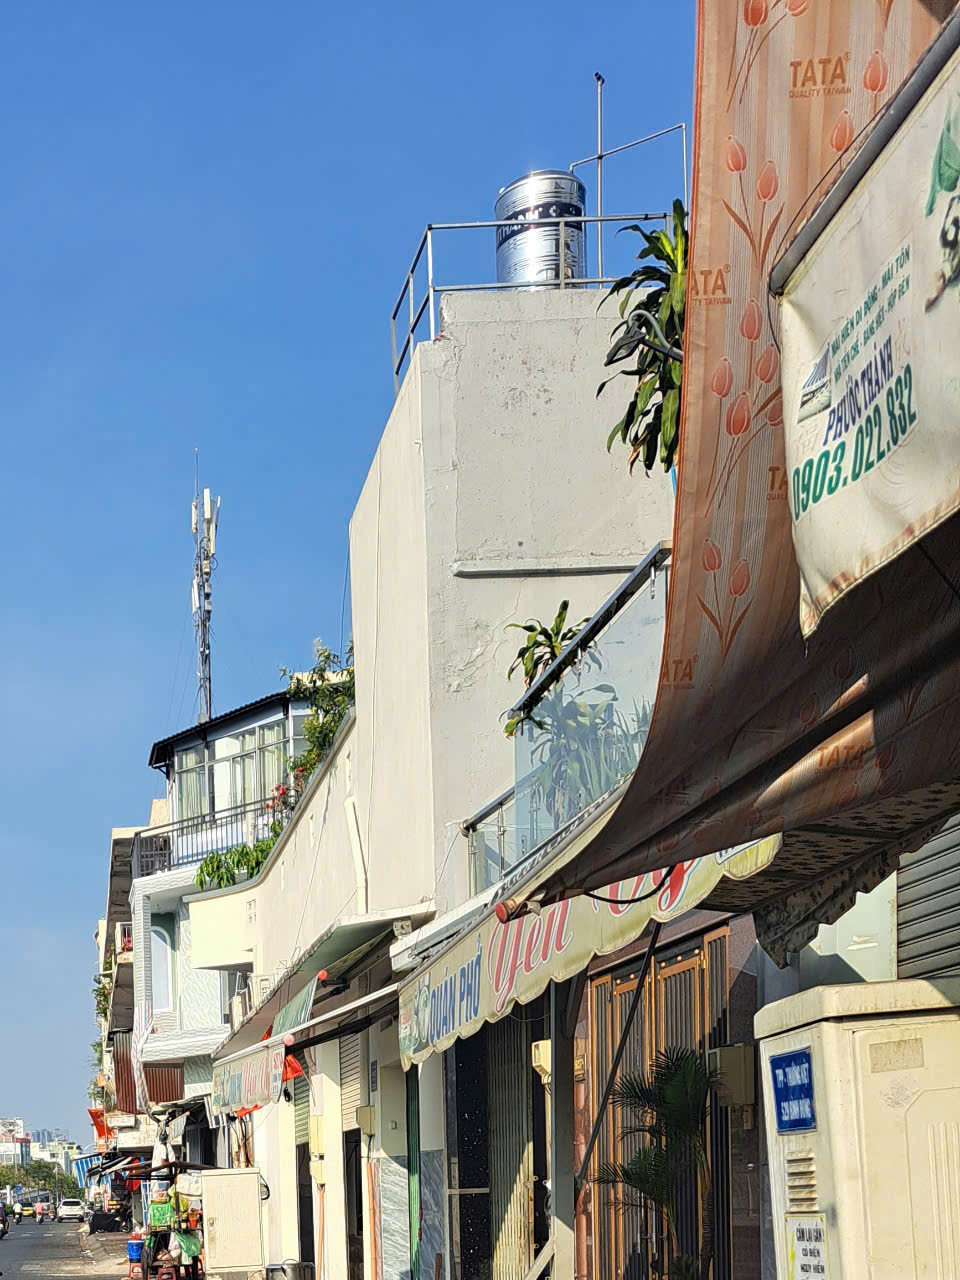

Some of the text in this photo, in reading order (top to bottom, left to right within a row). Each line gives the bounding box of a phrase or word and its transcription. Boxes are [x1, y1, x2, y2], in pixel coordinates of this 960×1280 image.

[790, 55, 846, 88] TATA
[793, 363, 917, 521] 0903.022.832
[429, 932, 482, 1045] QUÁN PHỞ
